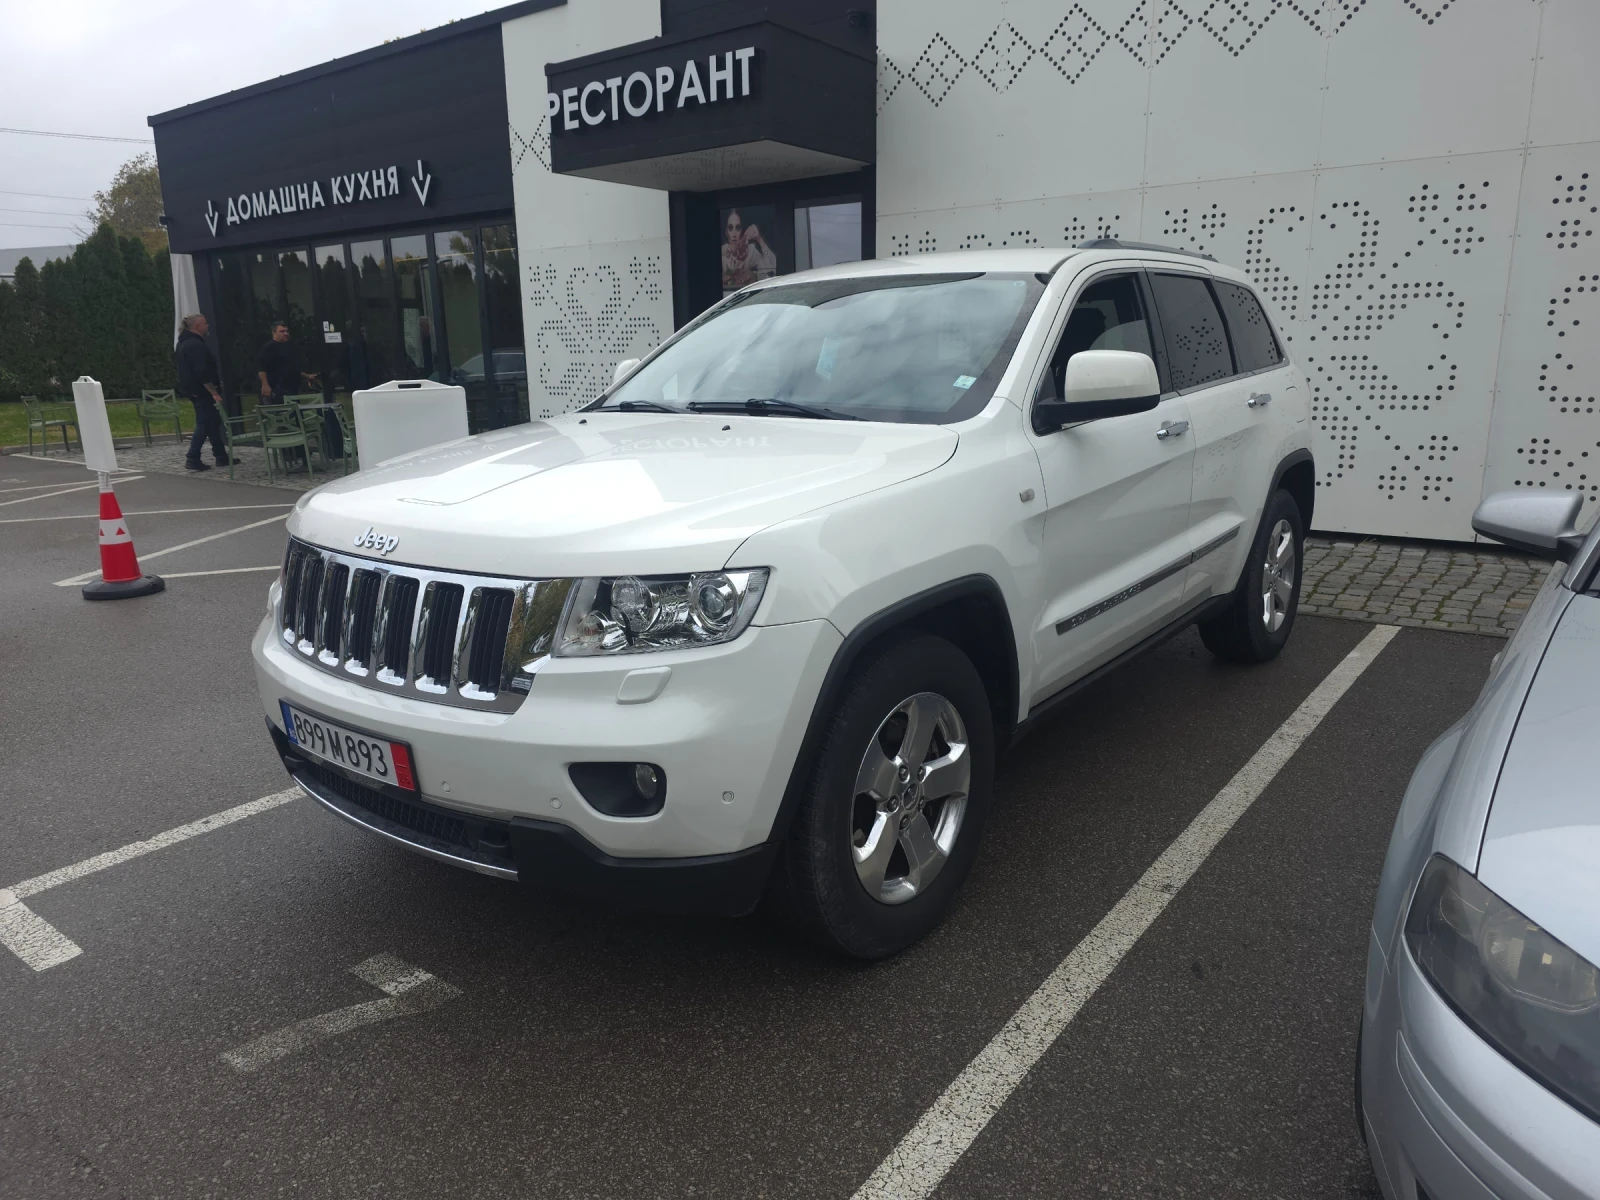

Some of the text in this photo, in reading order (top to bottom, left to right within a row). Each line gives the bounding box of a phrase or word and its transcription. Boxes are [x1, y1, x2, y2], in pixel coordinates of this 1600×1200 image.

[547, 46, 755, 133] РЕСТОРАНТ
[226, 166, 399, 225] ДОМАШНА КУХНЯ
[353, 525, 399, 556] Jeep
[293, 713, 388, 777] 899M893
